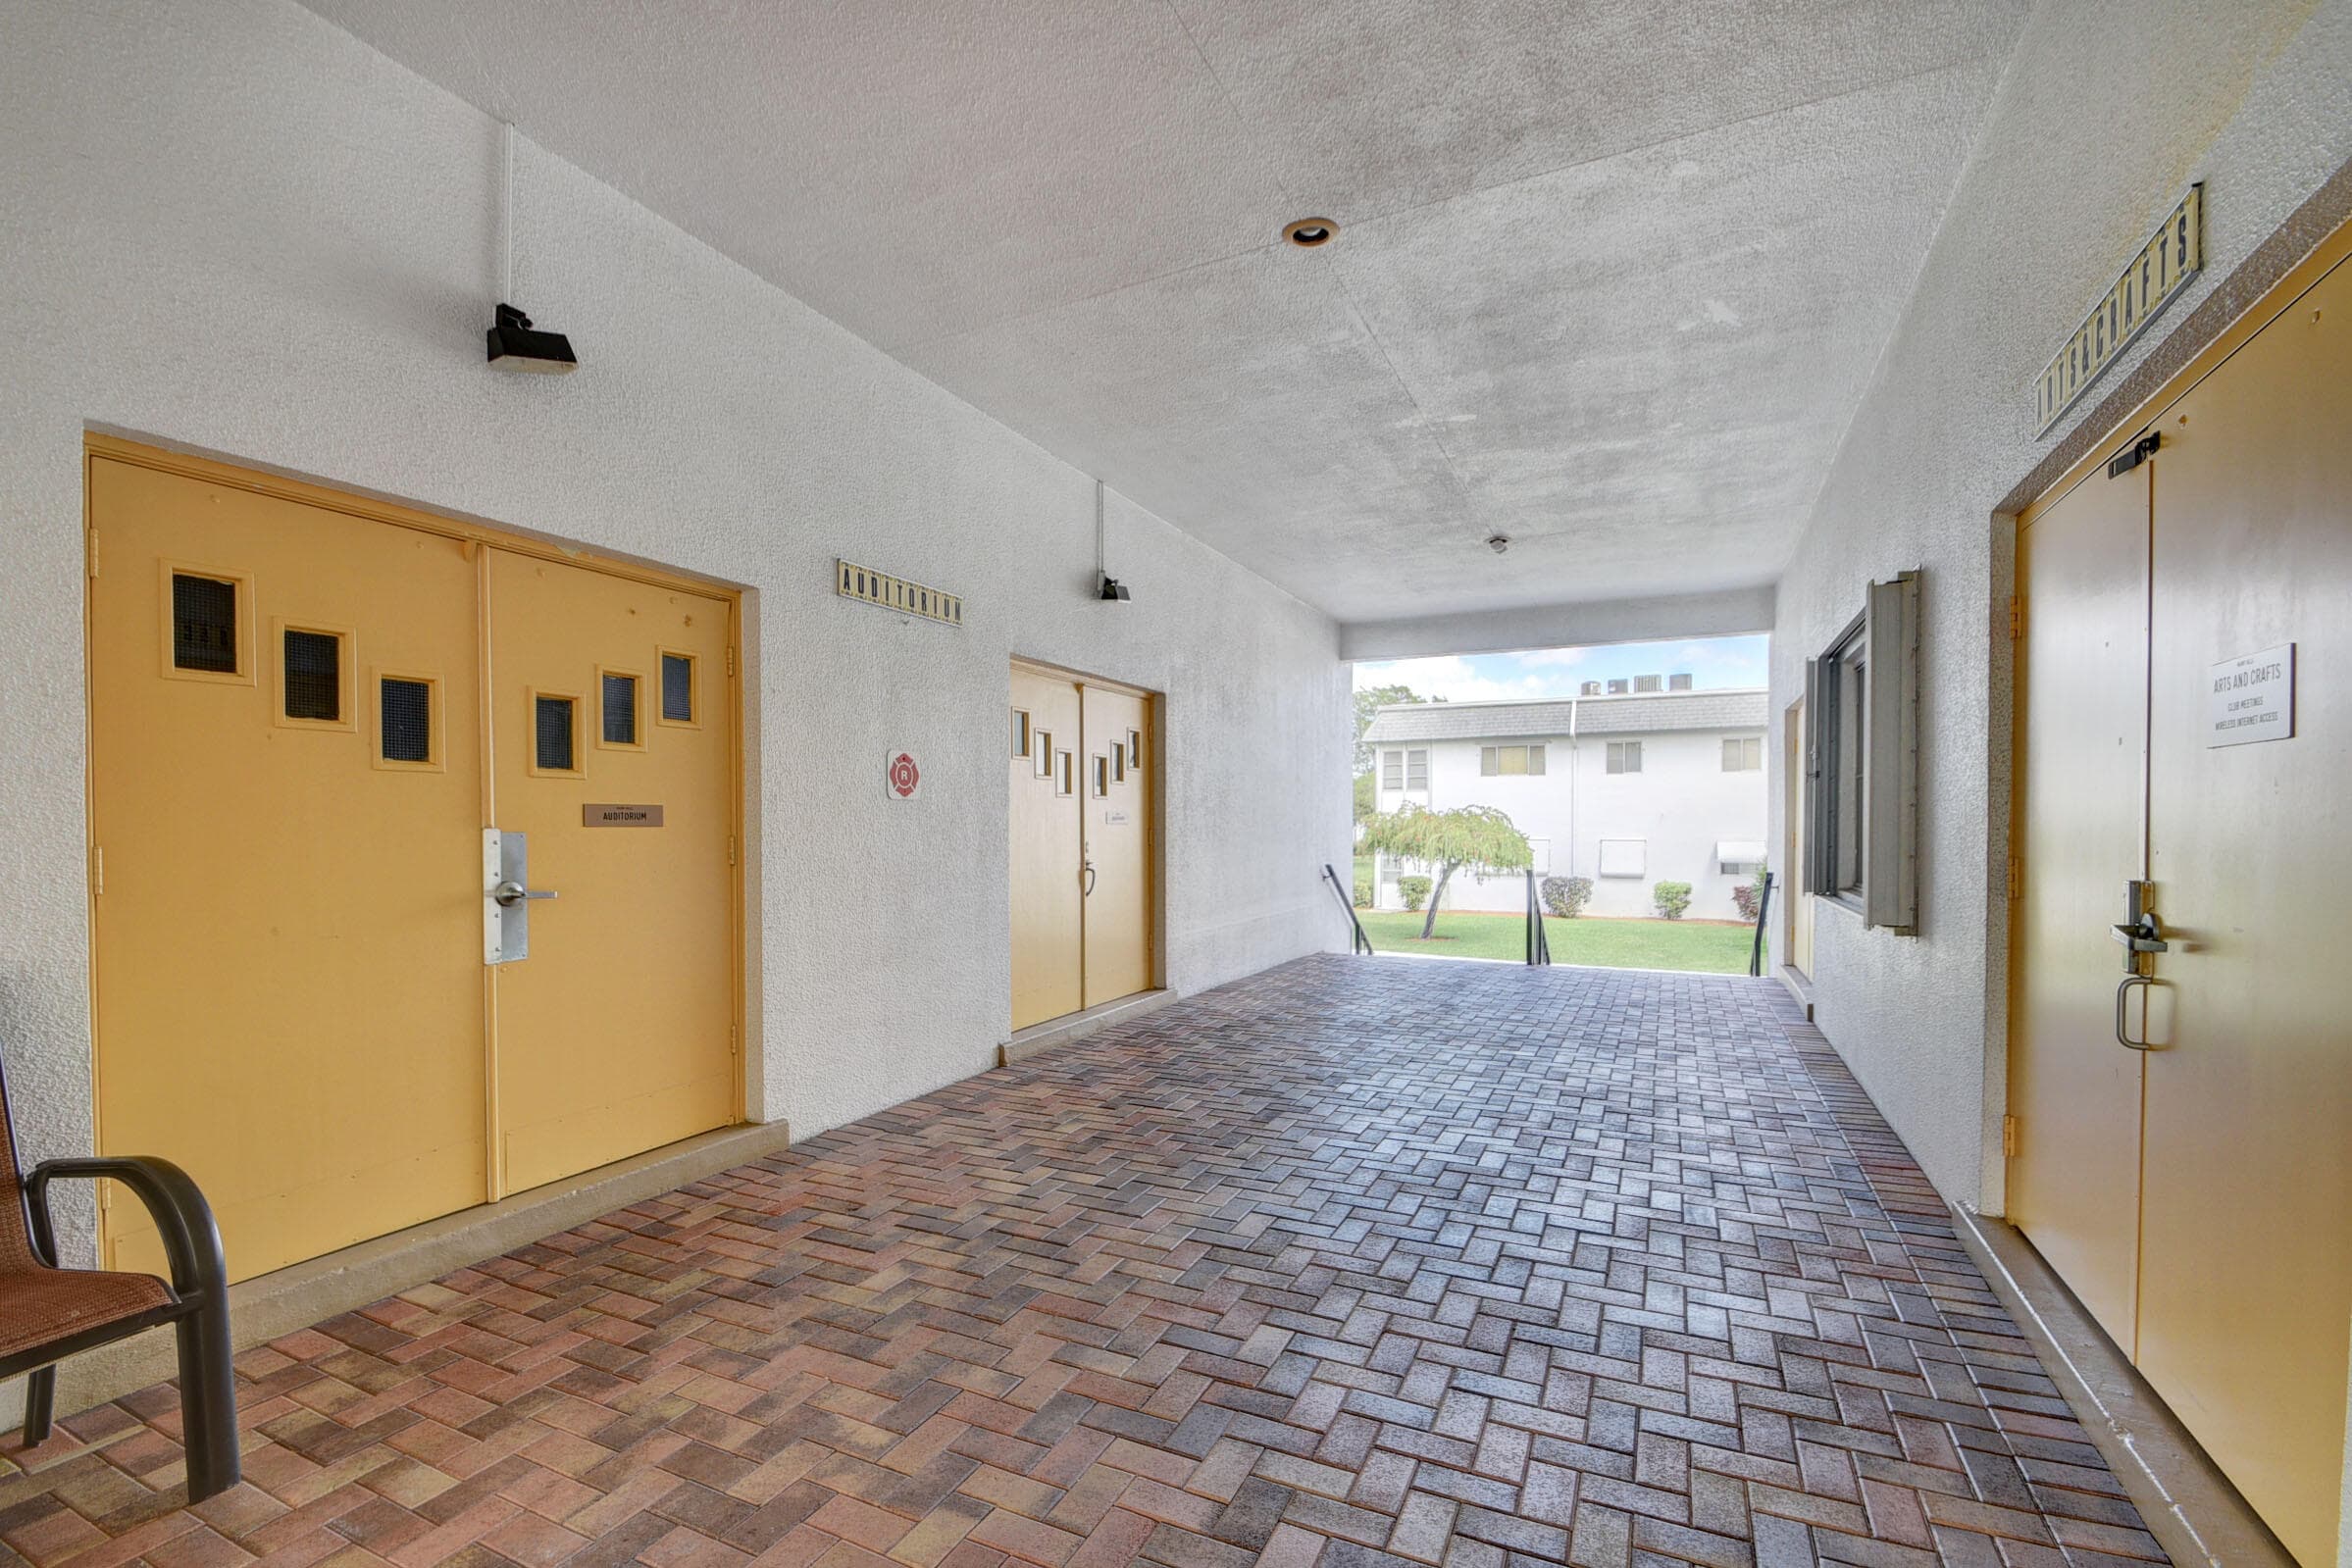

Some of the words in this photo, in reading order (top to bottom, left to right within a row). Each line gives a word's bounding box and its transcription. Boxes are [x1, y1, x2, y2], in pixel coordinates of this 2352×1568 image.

[844, 568, 961, 621] AUDITORIUM
[2214, 676, 2231, 692] ARTS
[2233, 671, 2248, 689] AND
[2250, 663, 2281, 685] CRAFTS
[2241, 696, 2263, 709] MEETINGS
[2237, 715, 2258, 728] INTERNET
[2259, 711, 2278, 724] ACCESS
[603, 812, 647, 821] AUDITORIUM
